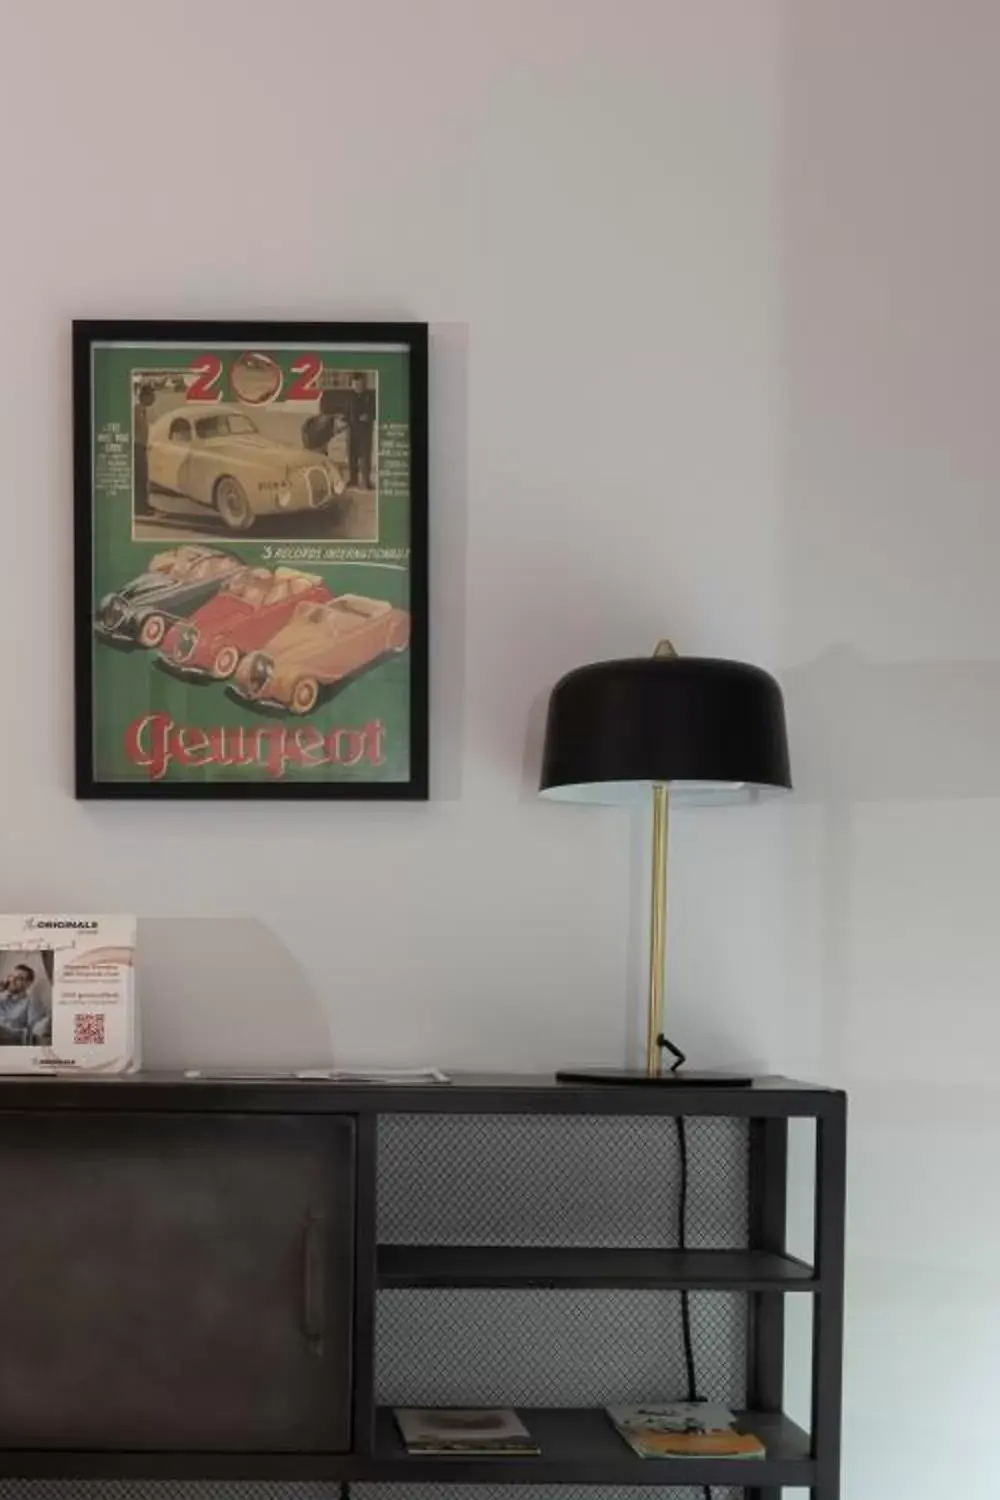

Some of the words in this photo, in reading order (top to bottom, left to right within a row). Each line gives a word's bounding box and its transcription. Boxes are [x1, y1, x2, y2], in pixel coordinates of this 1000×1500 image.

[185, 351, 323, 407] 202
[124, 709, 387, 780] Peugeot
[37, 920, 99, 929] ORIGINALS
